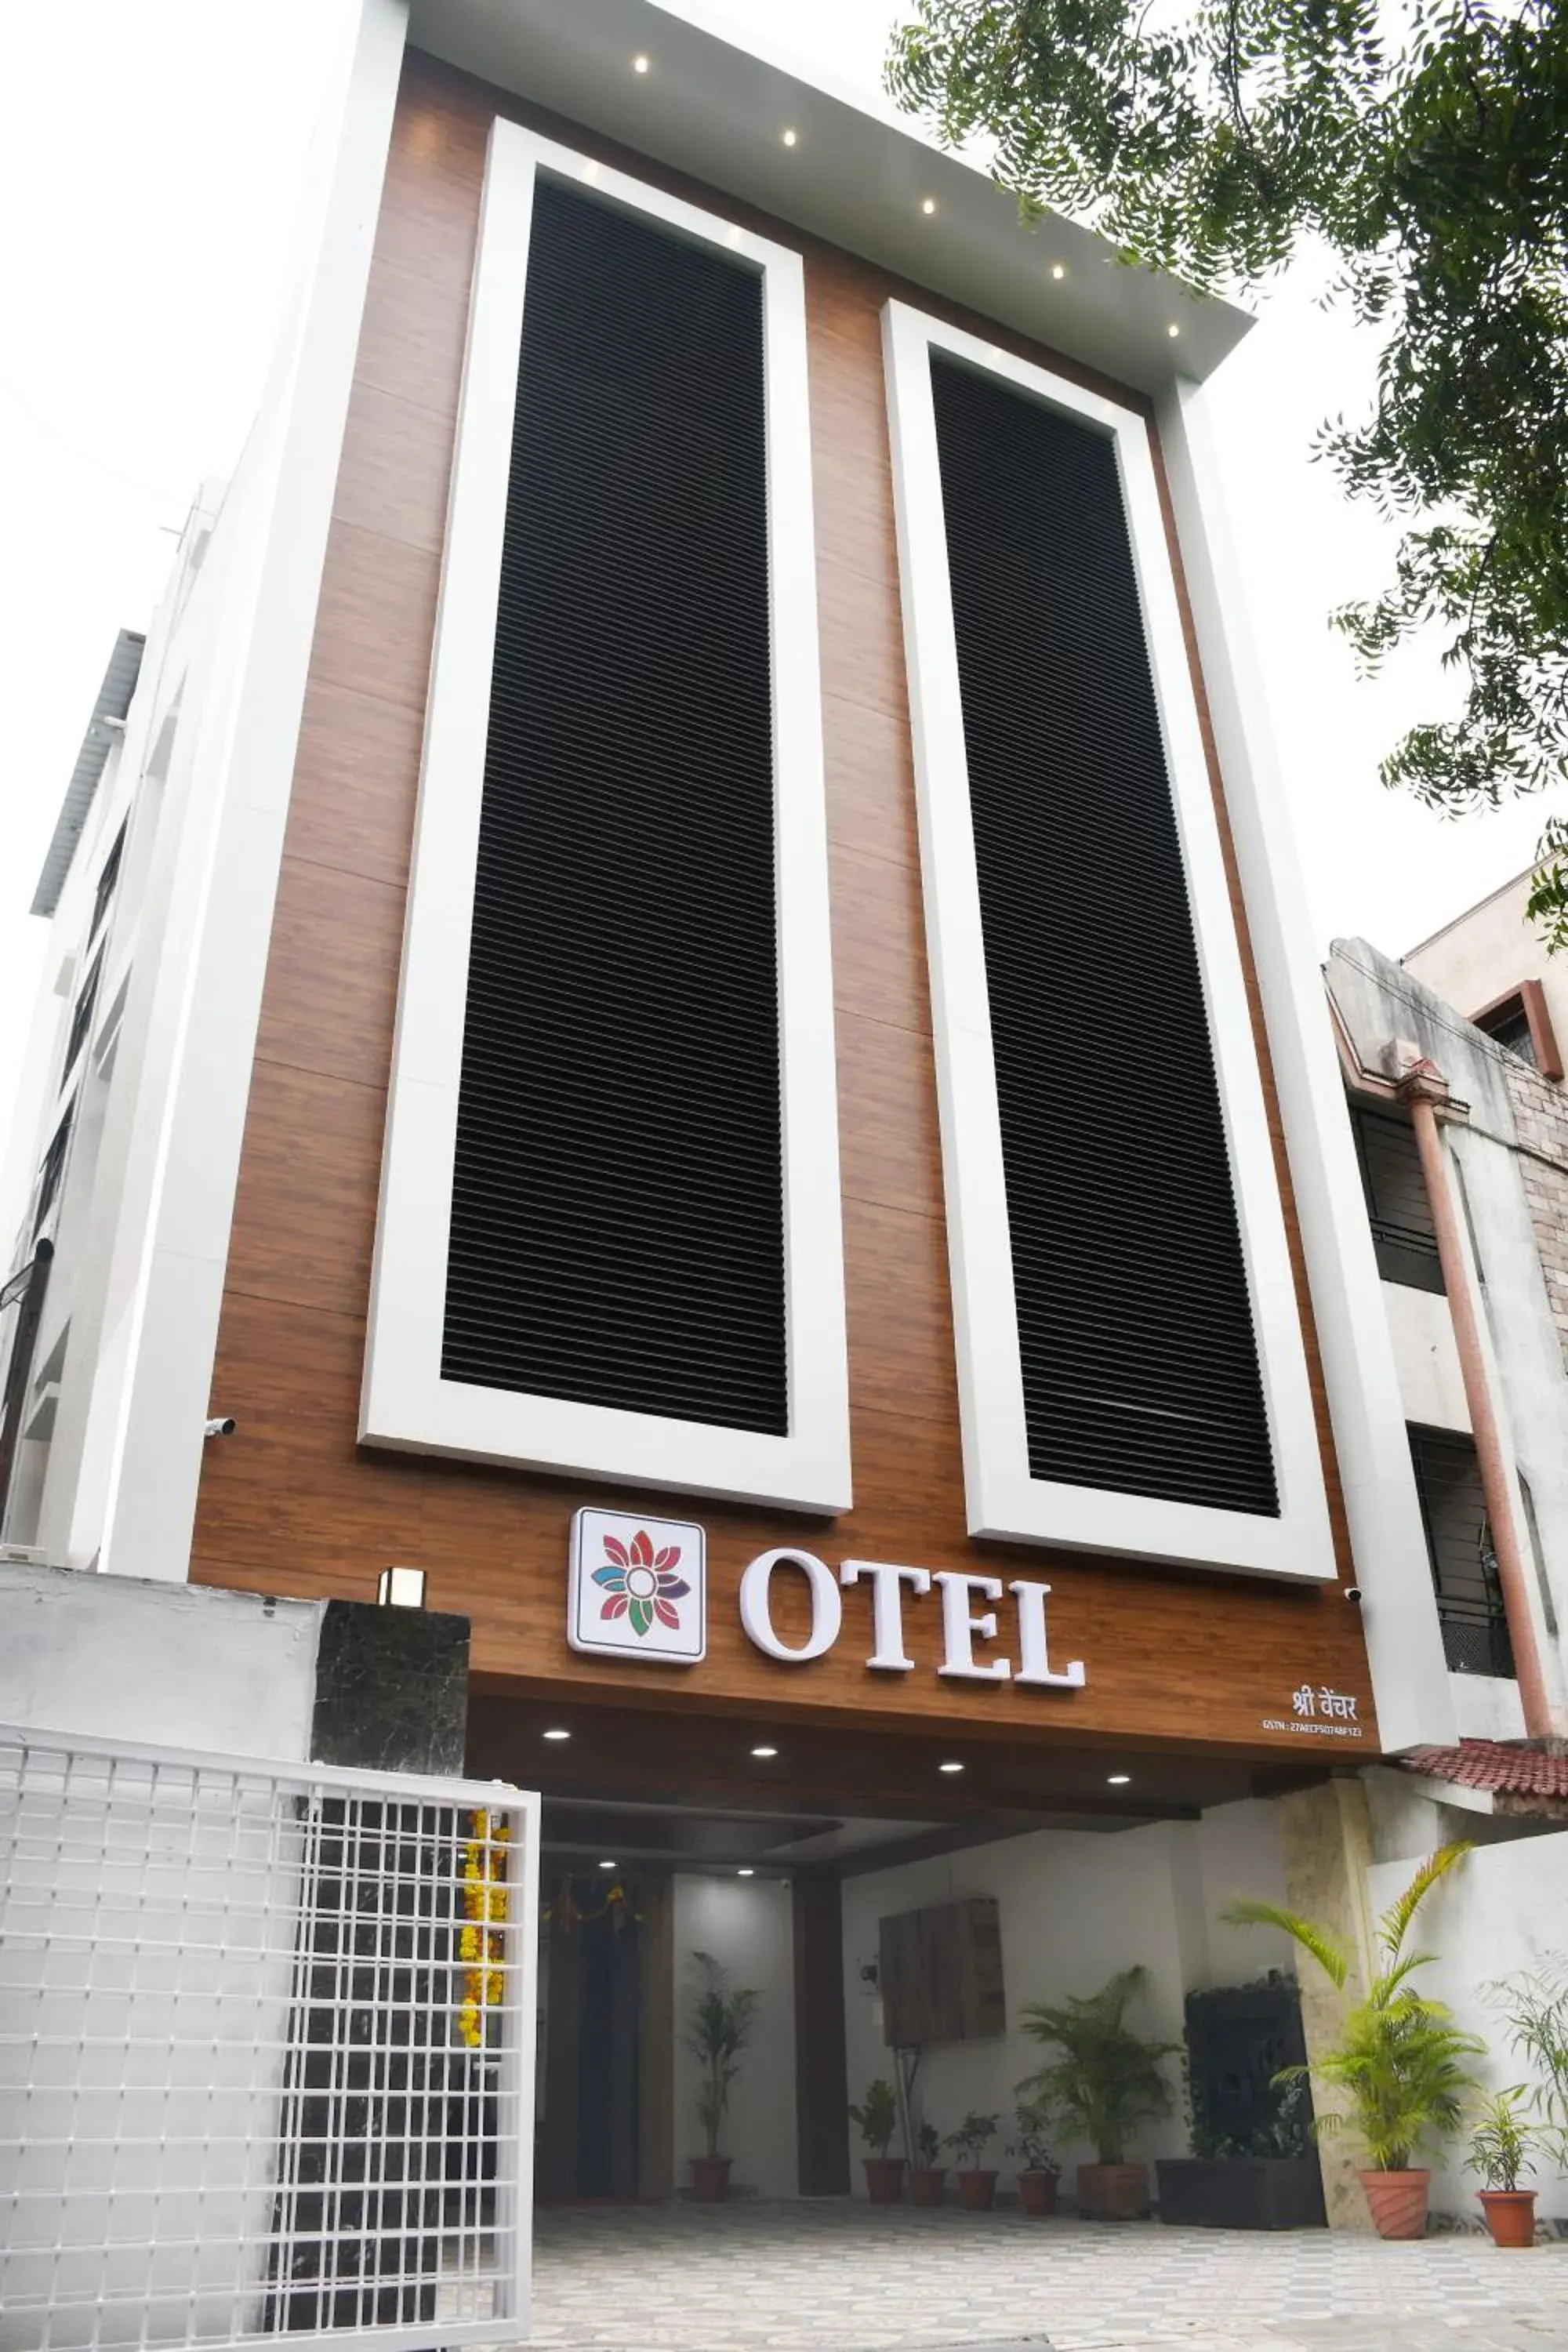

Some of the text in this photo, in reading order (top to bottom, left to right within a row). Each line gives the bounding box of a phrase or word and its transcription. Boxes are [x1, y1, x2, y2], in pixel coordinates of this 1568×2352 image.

[739, 1547, 1087, 1688] OTEL
[1292, 1684, 1358, 1719] श्री वेंचर
